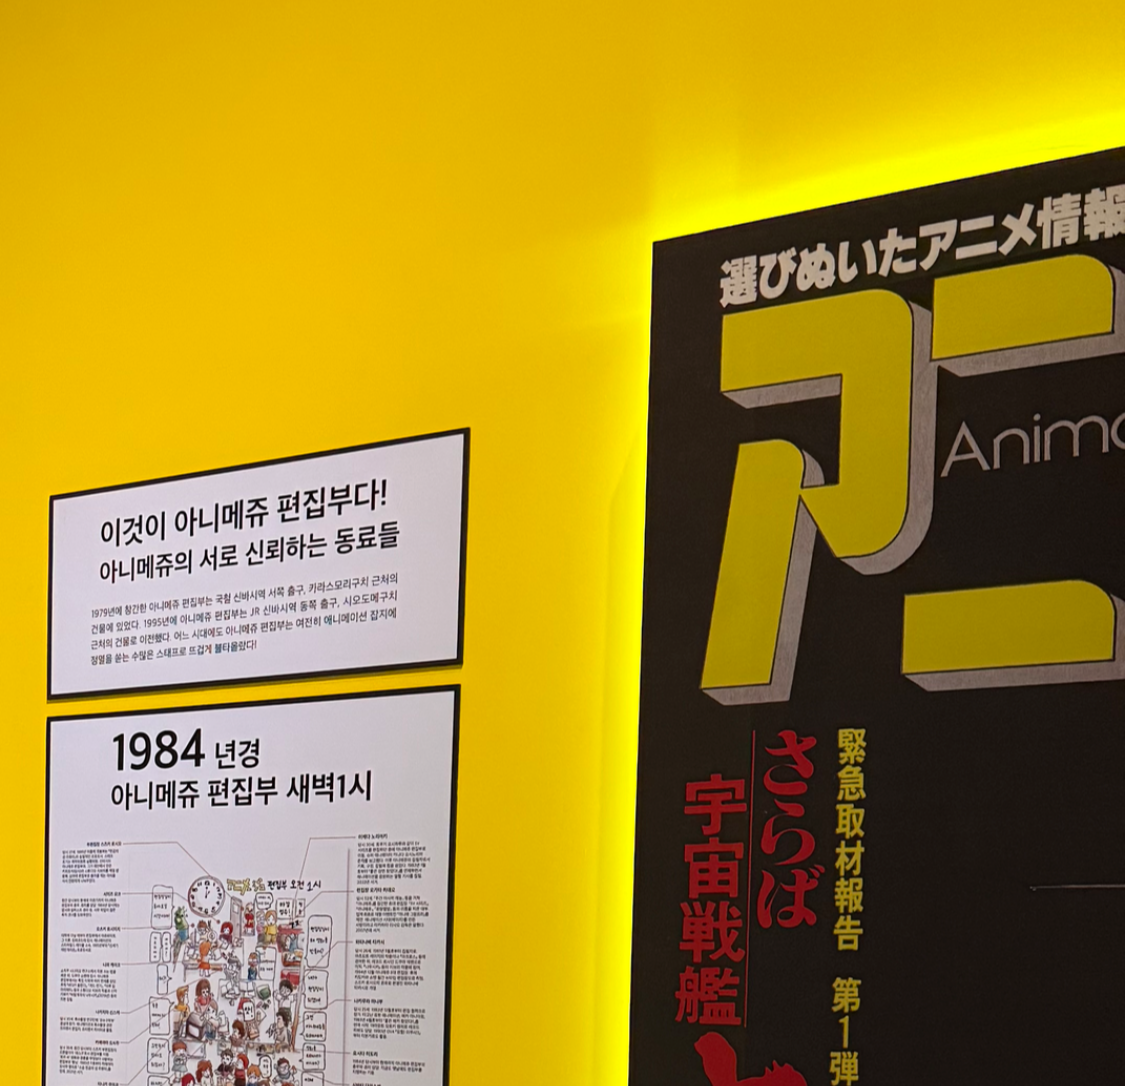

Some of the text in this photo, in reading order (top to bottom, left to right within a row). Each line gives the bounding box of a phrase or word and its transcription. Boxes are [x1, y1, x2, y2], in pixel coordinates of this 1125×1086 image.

[100, 478, 387, 547] 이것이 아니메쥬 편집부다!
[99, 520, 400, 584] 아니메쥬의 서로 신뢰하는 동료들
[112, 727, 260, 771] 1984 년경
[110, 769, 371, 811] 아니메쥬 편집부 새벽1시
[757, 730, 824, 929] さらば
[833, 728, 866, 951] 緊急取材報告
[675, 774, 747, 1026] 宇宙戦艦
